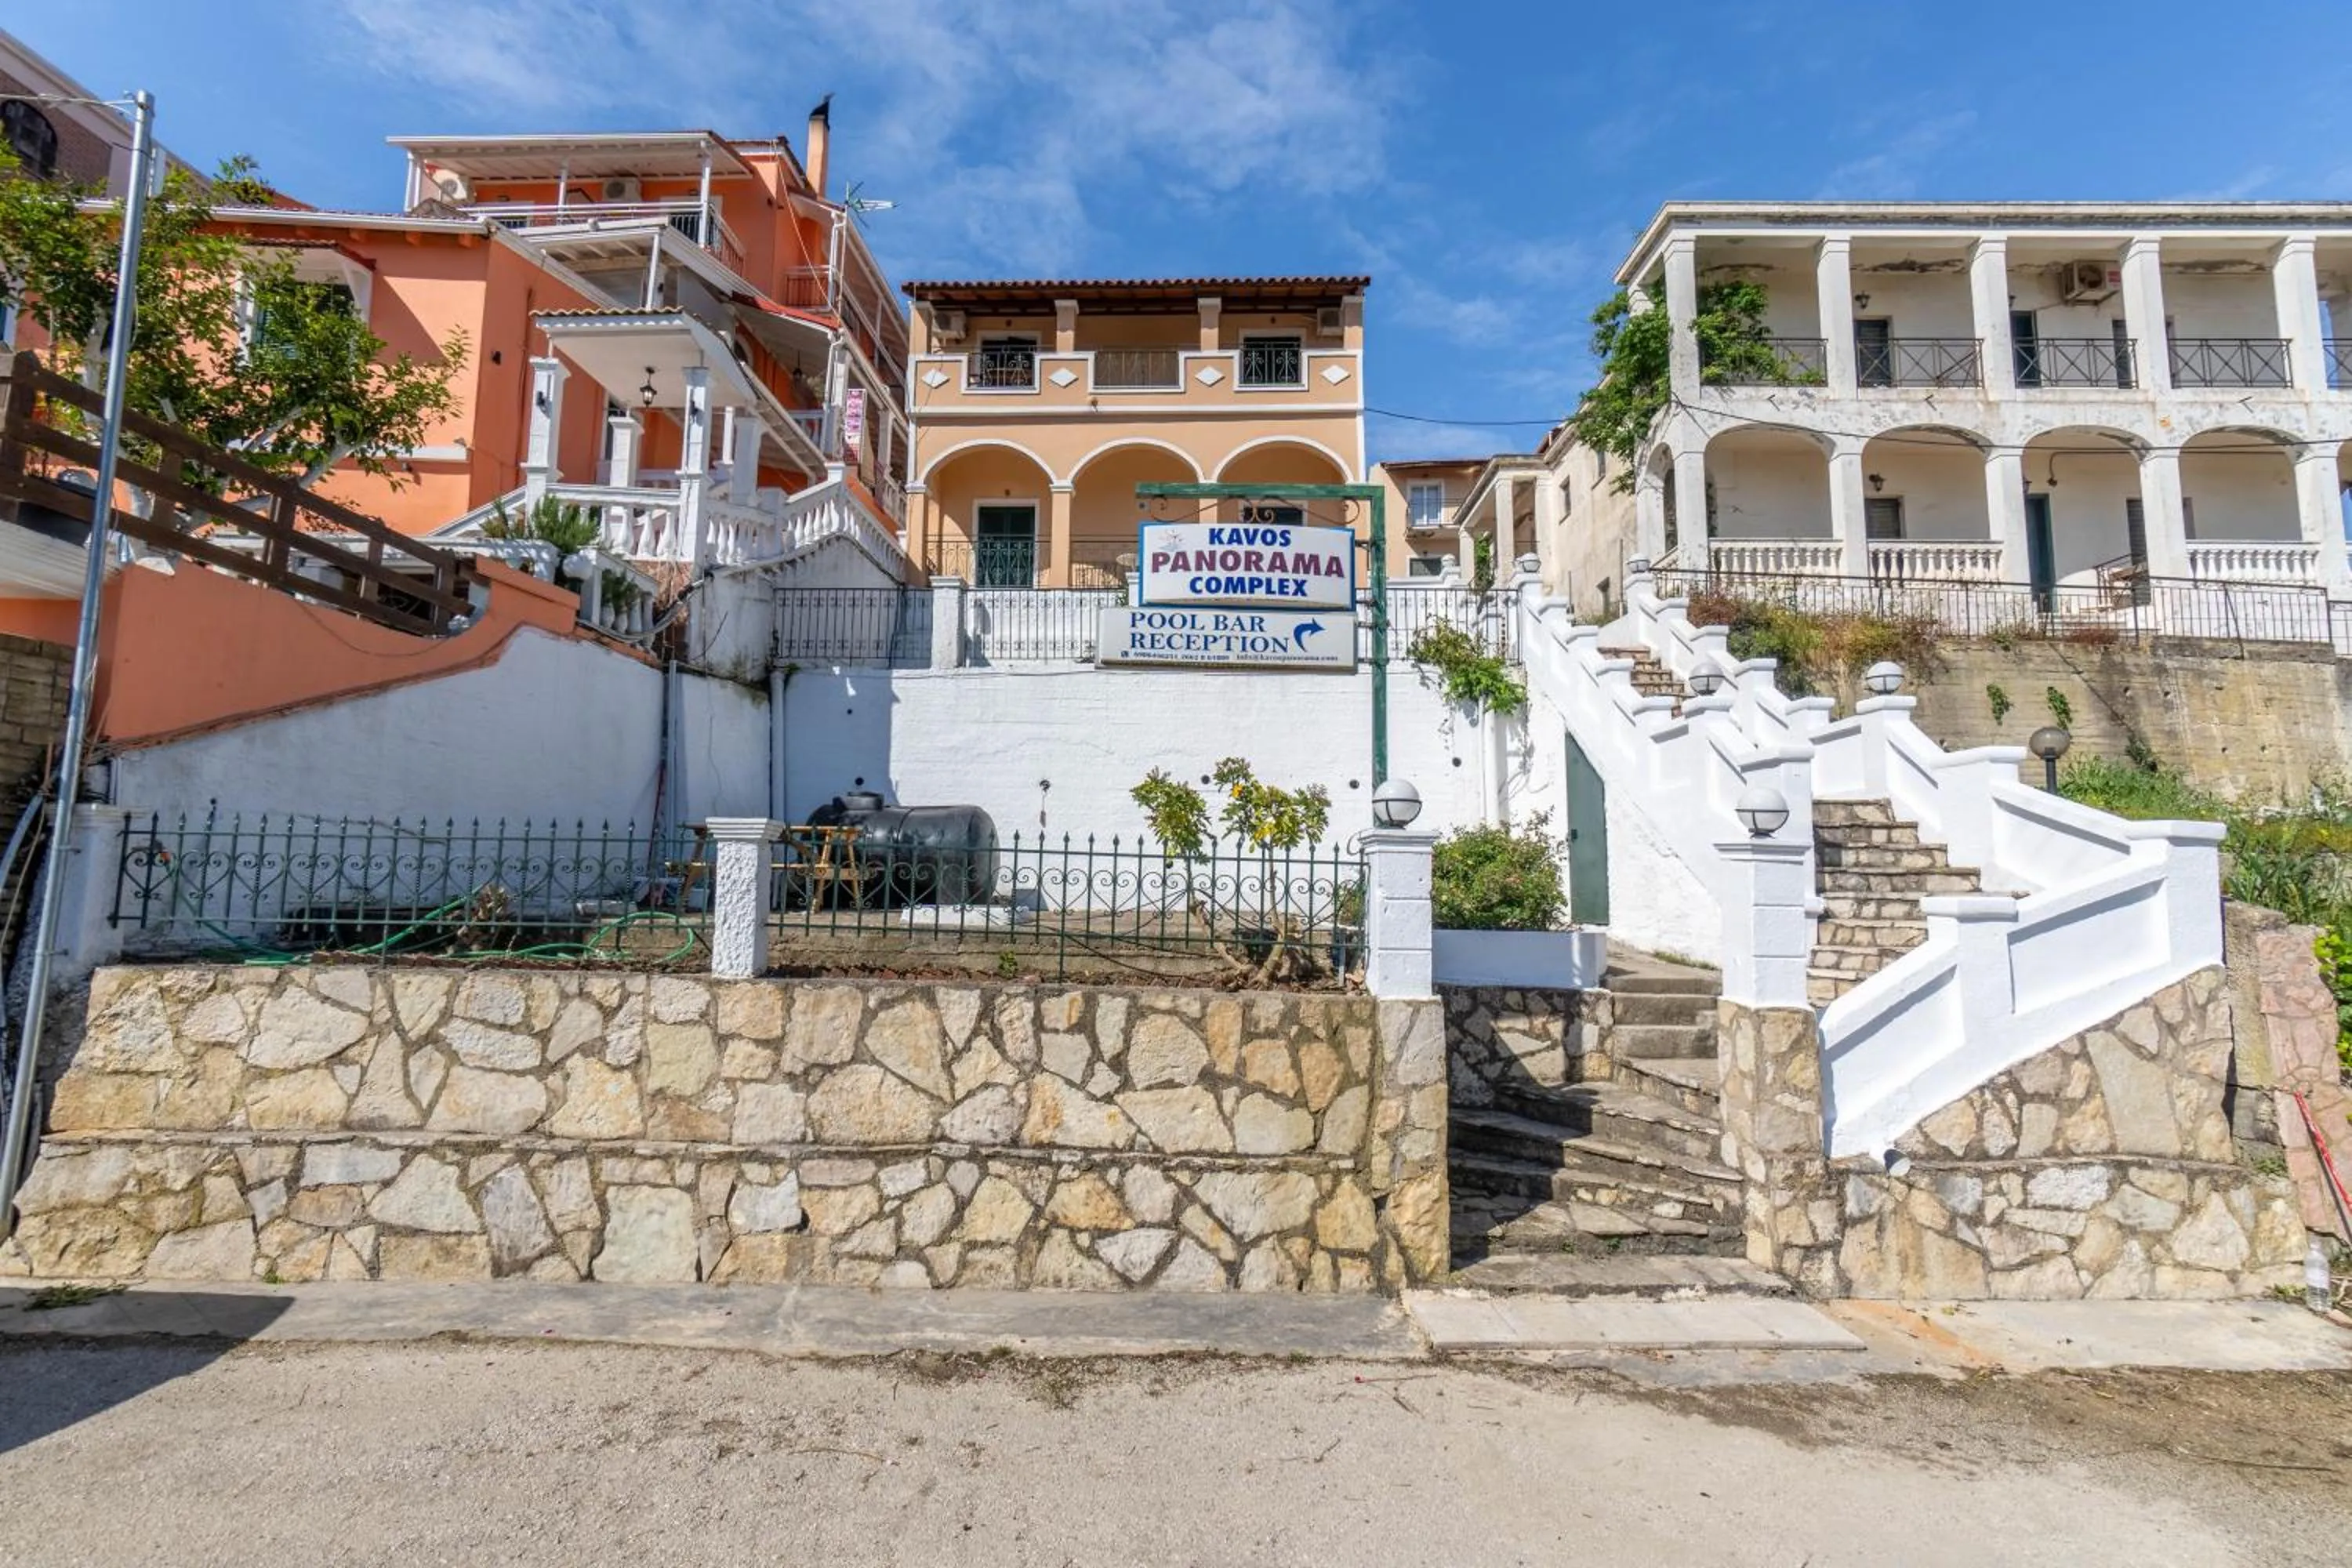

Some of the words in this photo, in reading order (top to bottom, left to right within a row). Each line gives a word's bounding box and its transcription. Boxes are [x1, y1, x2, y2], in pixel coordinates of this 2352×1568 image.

[1208, 528, 1291, 546] KAVOS
[1151, 550, 1345, 579] PANORAMA
[1189, 576, 1308, 597] COMPLEX
[1130, 612, 1207, 630] POOL
[1214, 614, 1267, 633] BAR
[1130, 633, 1291, 653] RECEPTION
